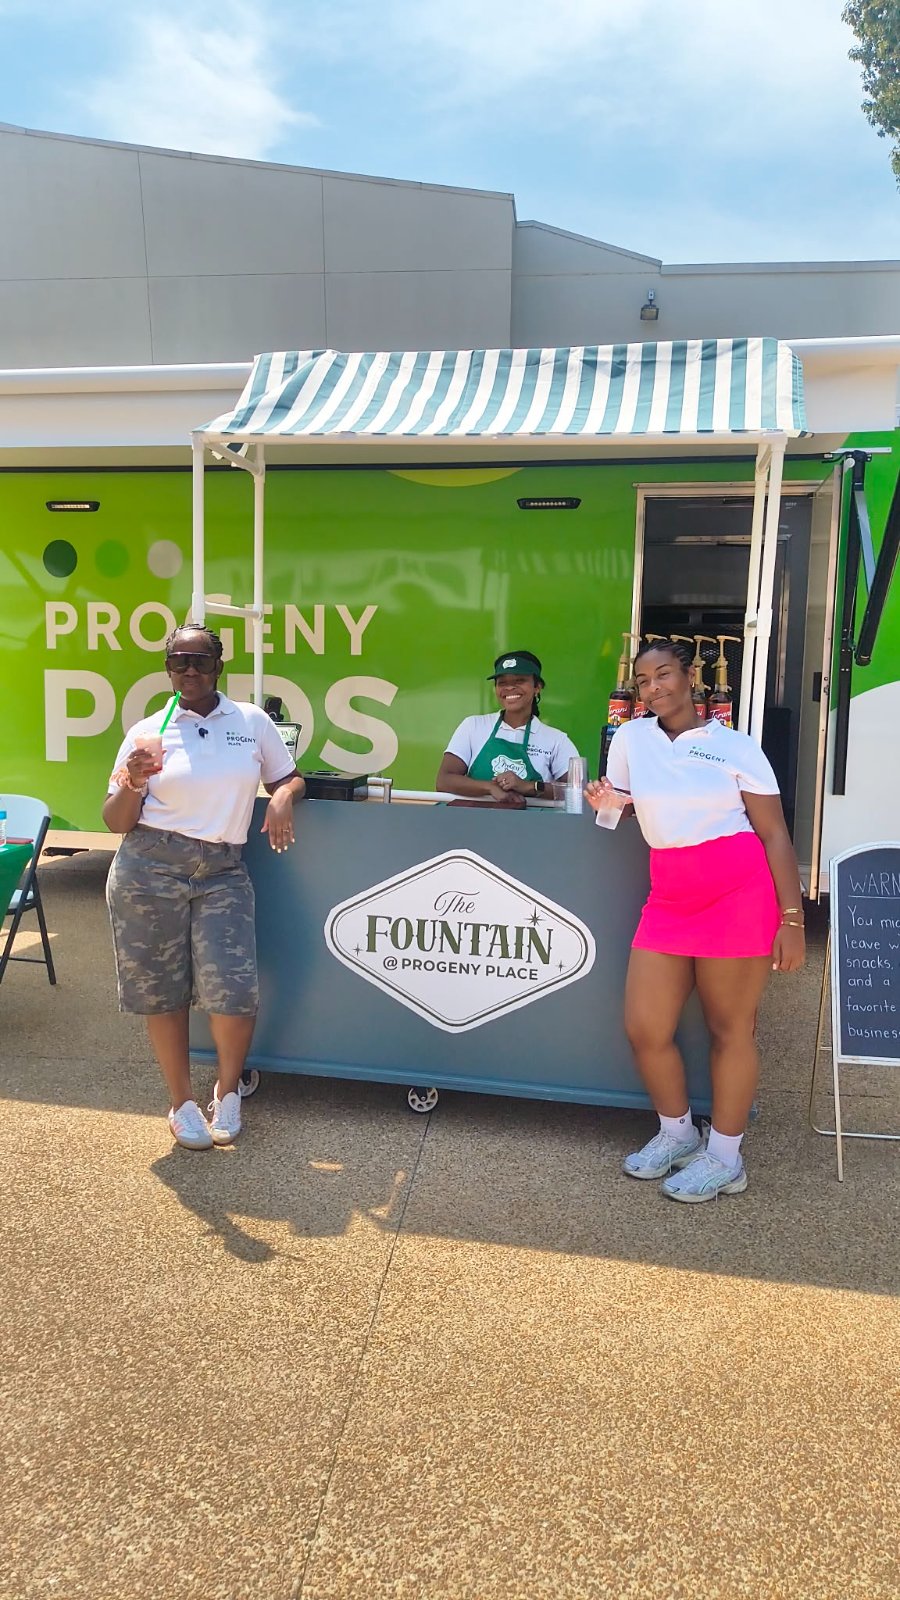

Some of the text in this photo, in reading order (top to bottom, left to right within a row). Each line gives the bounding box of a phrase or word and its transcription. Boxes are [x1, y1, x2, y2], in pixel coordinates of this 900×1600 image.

[226, 736, 256, 744] PROGENY
[689, 749, 727, 763] PROGENY
[433, 890, 480, 916] The
[847, 904, 873, 928] You
[365, 914, 554, 965] FOUNTAIN
[845, 933, 881, 950] leave
[382, 956, 539, 981] @ PROGENY PLACE
[848, 973, 873, 988] and
[846, 995, 897, 1012] favorite
[847, 1021, 900, 1039] busines
